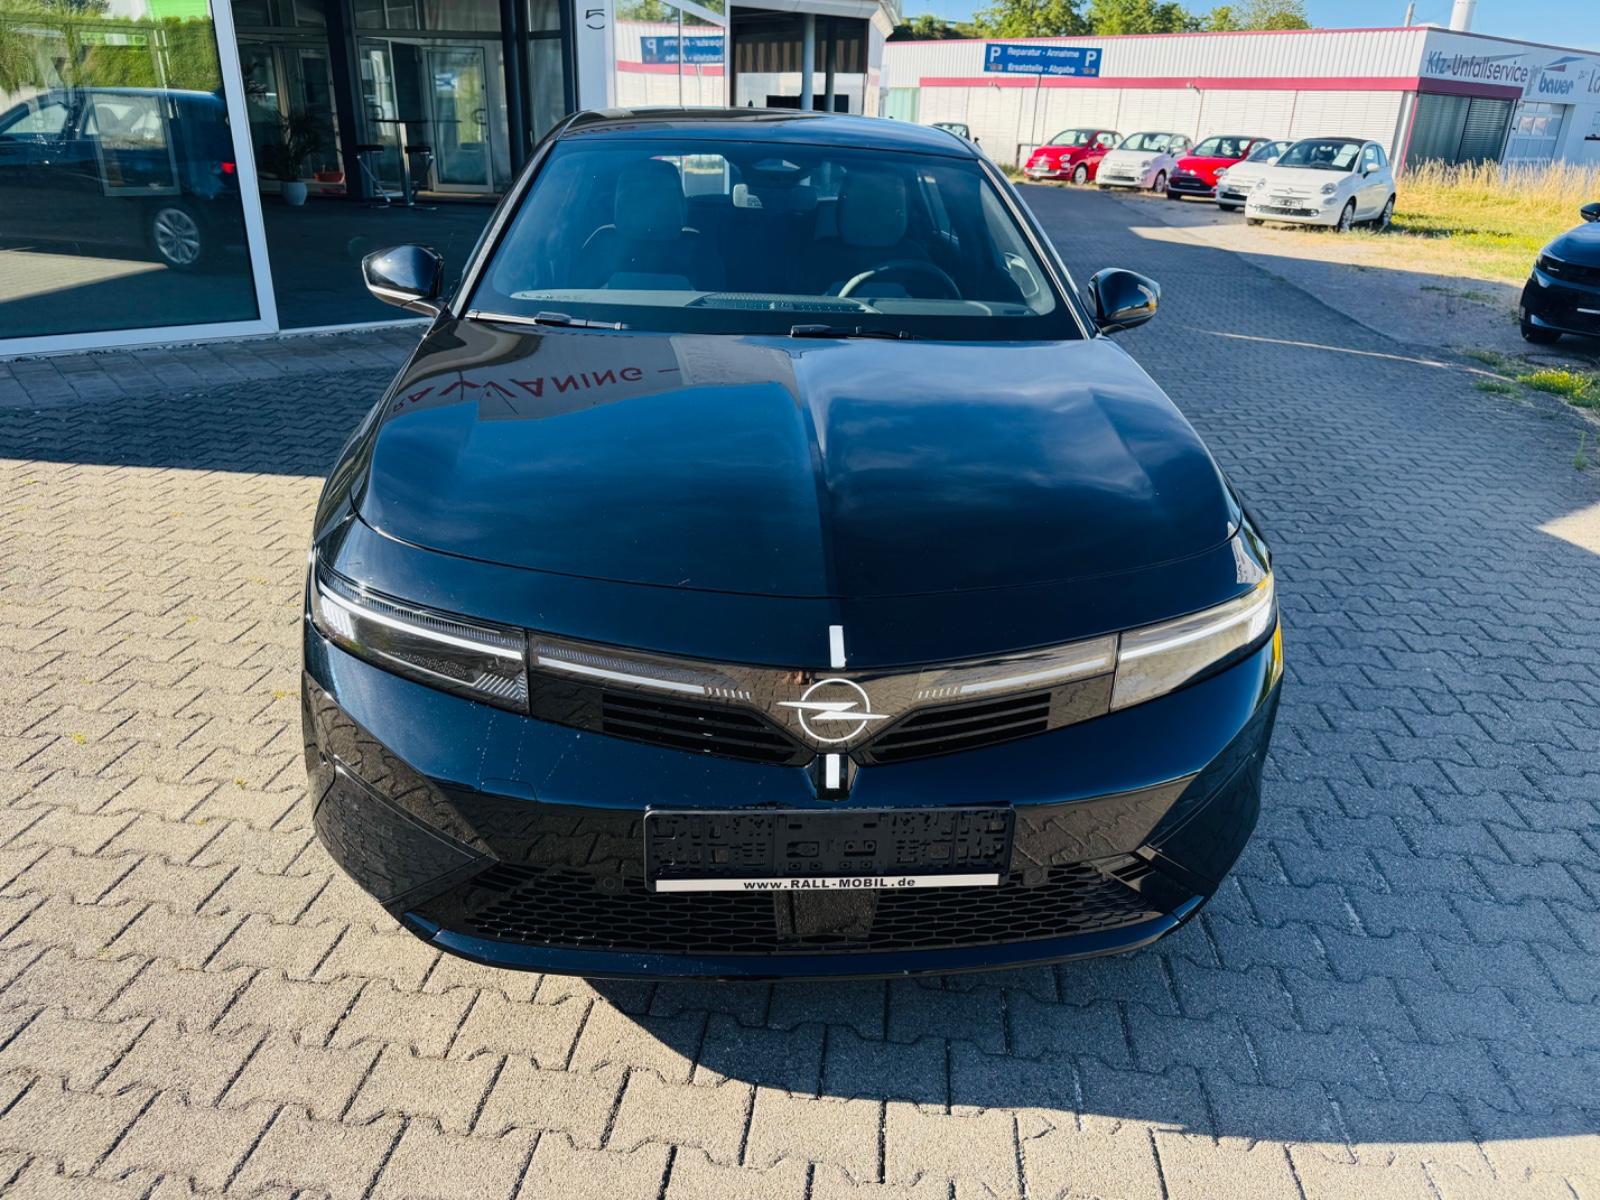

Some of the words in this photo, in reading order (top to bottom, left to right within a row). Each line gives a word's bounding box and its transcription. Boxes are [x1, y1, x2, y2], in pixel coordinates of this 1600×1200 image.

[990, 46, 1001, 62] P
[1008, 47, 1041, 57] Reparatur
[1046, 49, 1080, 58] Annahme
[1085, 51, 1097, 66] P
[1007, 63, 1043, 73] Ersatzteile
[1048, 65, 1075, 75] Abgabe
[1425, 51, 1528, 83] Kfz-Unfallservice
[1538, 72, 1574, 94] bauer
[743, 877, 916, 889] www.RALL-MOBIL.de
